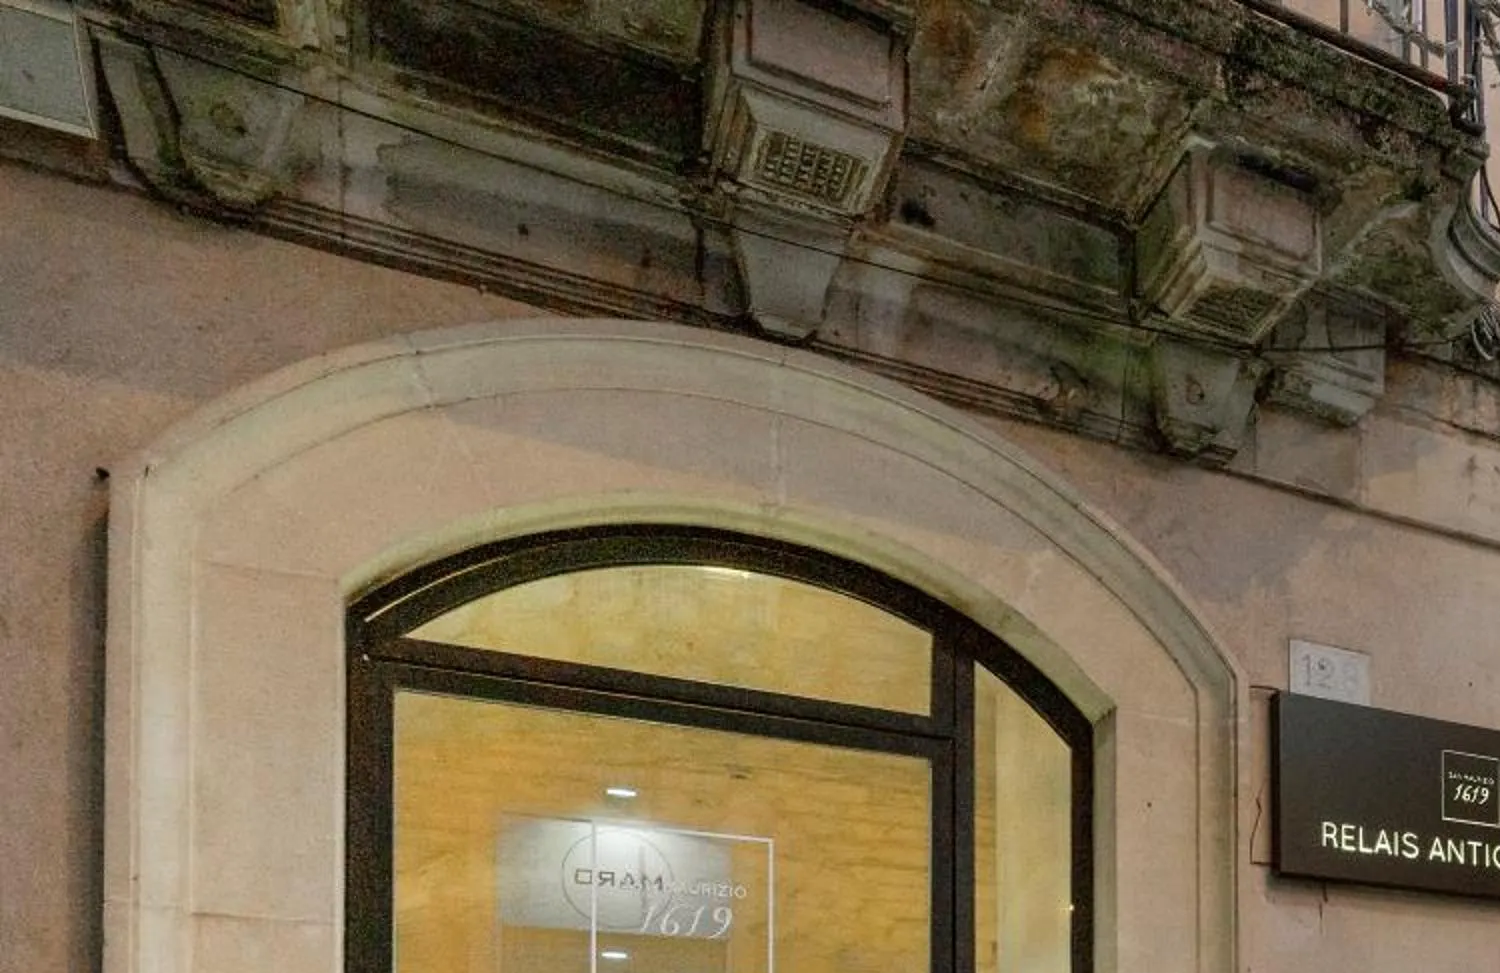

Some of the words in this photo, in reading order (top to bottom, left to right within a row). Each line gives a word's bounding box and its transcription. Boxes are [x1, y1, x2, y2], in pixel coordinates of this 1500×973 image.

[1453, 783, 1490, 805] 1619
[1321, 822, 1420, 860] RELAIS
[640, 906, 733, 939] 1619
